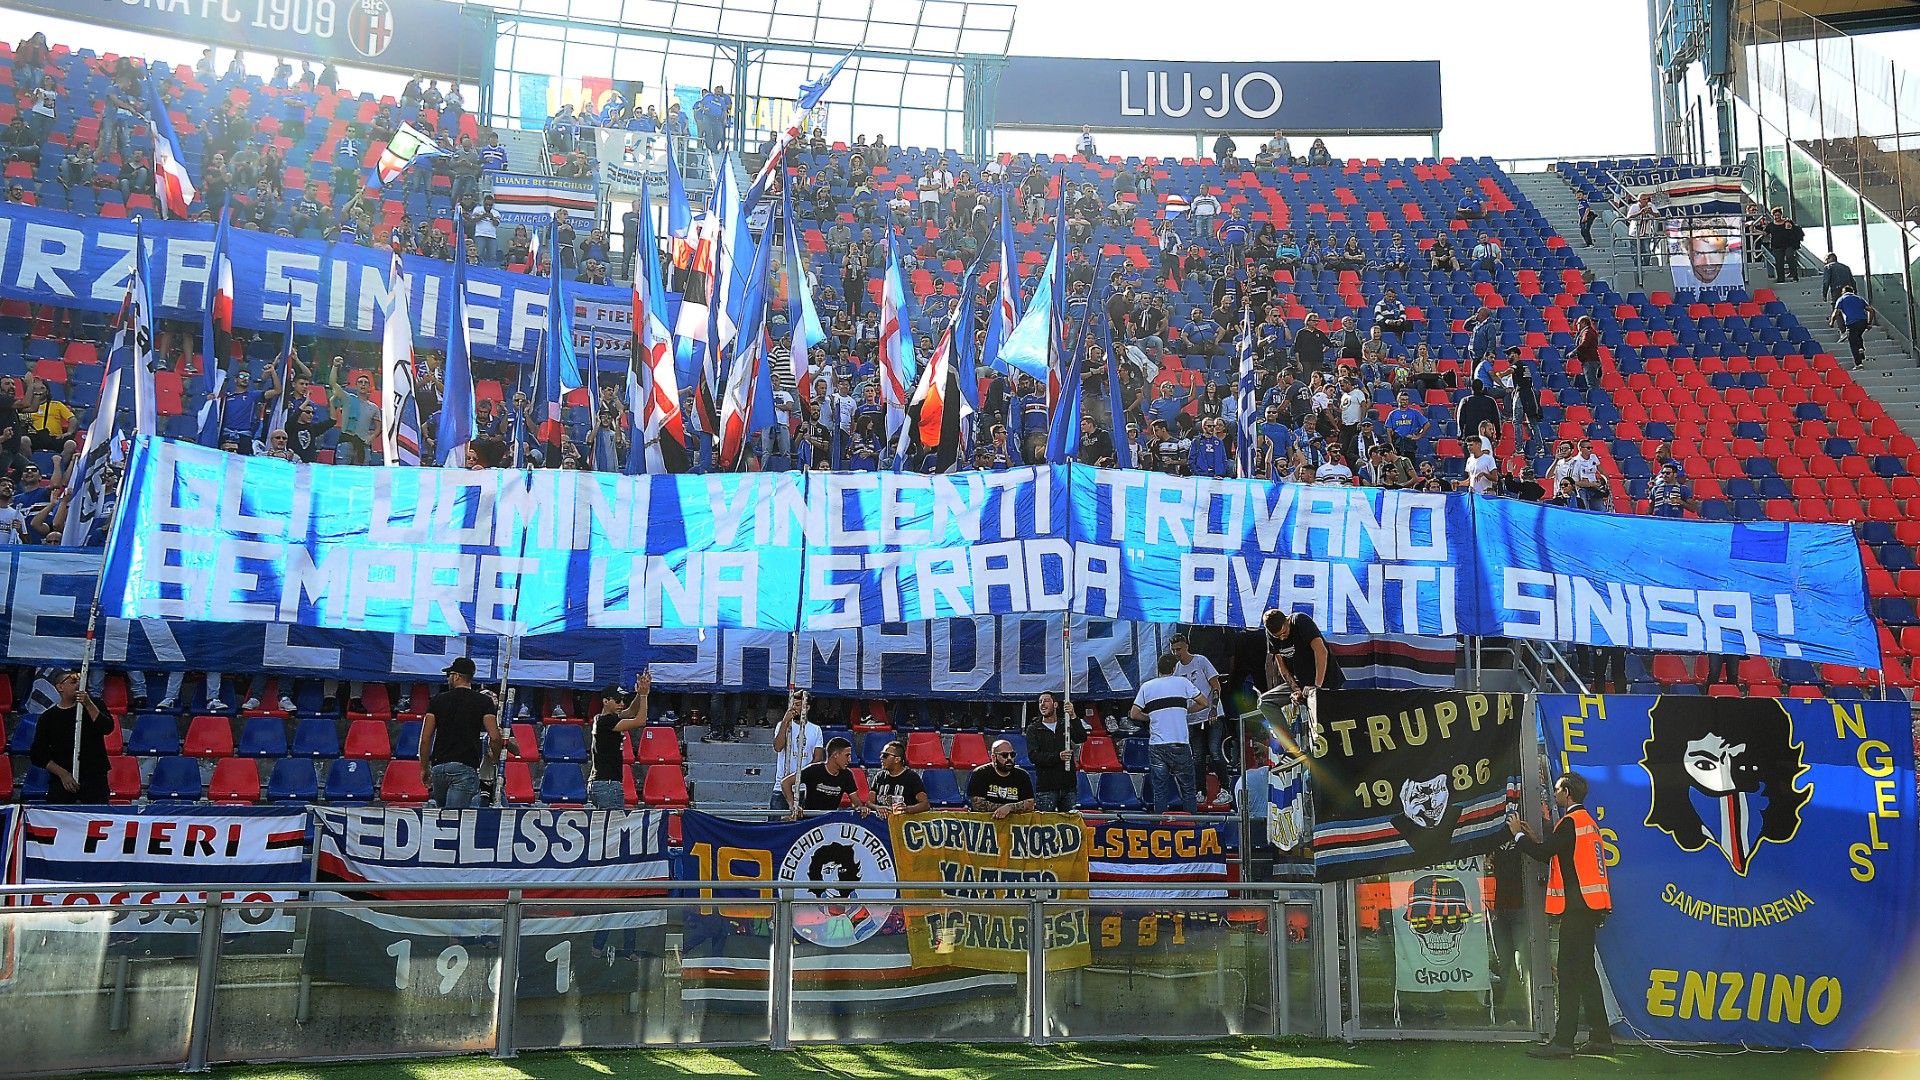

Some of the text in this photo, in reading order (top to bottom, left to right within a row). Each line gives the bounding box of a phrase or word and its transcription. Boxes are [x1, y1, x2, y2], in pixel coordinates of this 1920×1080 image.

[251, 0, 336, 38] 1909
[495, 176, 530, 186] LEVANTE
[0, 217, 216, 310] RZA
[150, 440, 1447, 561] GLI UOMINI VINCENTI TROVANO
[143, 532, 540, 636] SEMPRE
[586, 552, 759, 627] UNA
[1180, 552, 1456, 636] AVANTI
[648, 612, 1177, 694] SAMPDORI
[1312, 692, 1514, 759] STRUPPA
[1803, 697, 1900, 882] NGELS
[83, 820, 243, 859] FIERI
[840, 824, 892, 872] ULTRAS
[902, 818, 1083, 860] CURVA NORD
[1661, 882, 1816, 929] SAMPIERDARENA
[386, 938, 572, 995] 191
[1414, 967, 1474, 985] GROUP
[1645, 967, 1843, 1027] ENZINO
